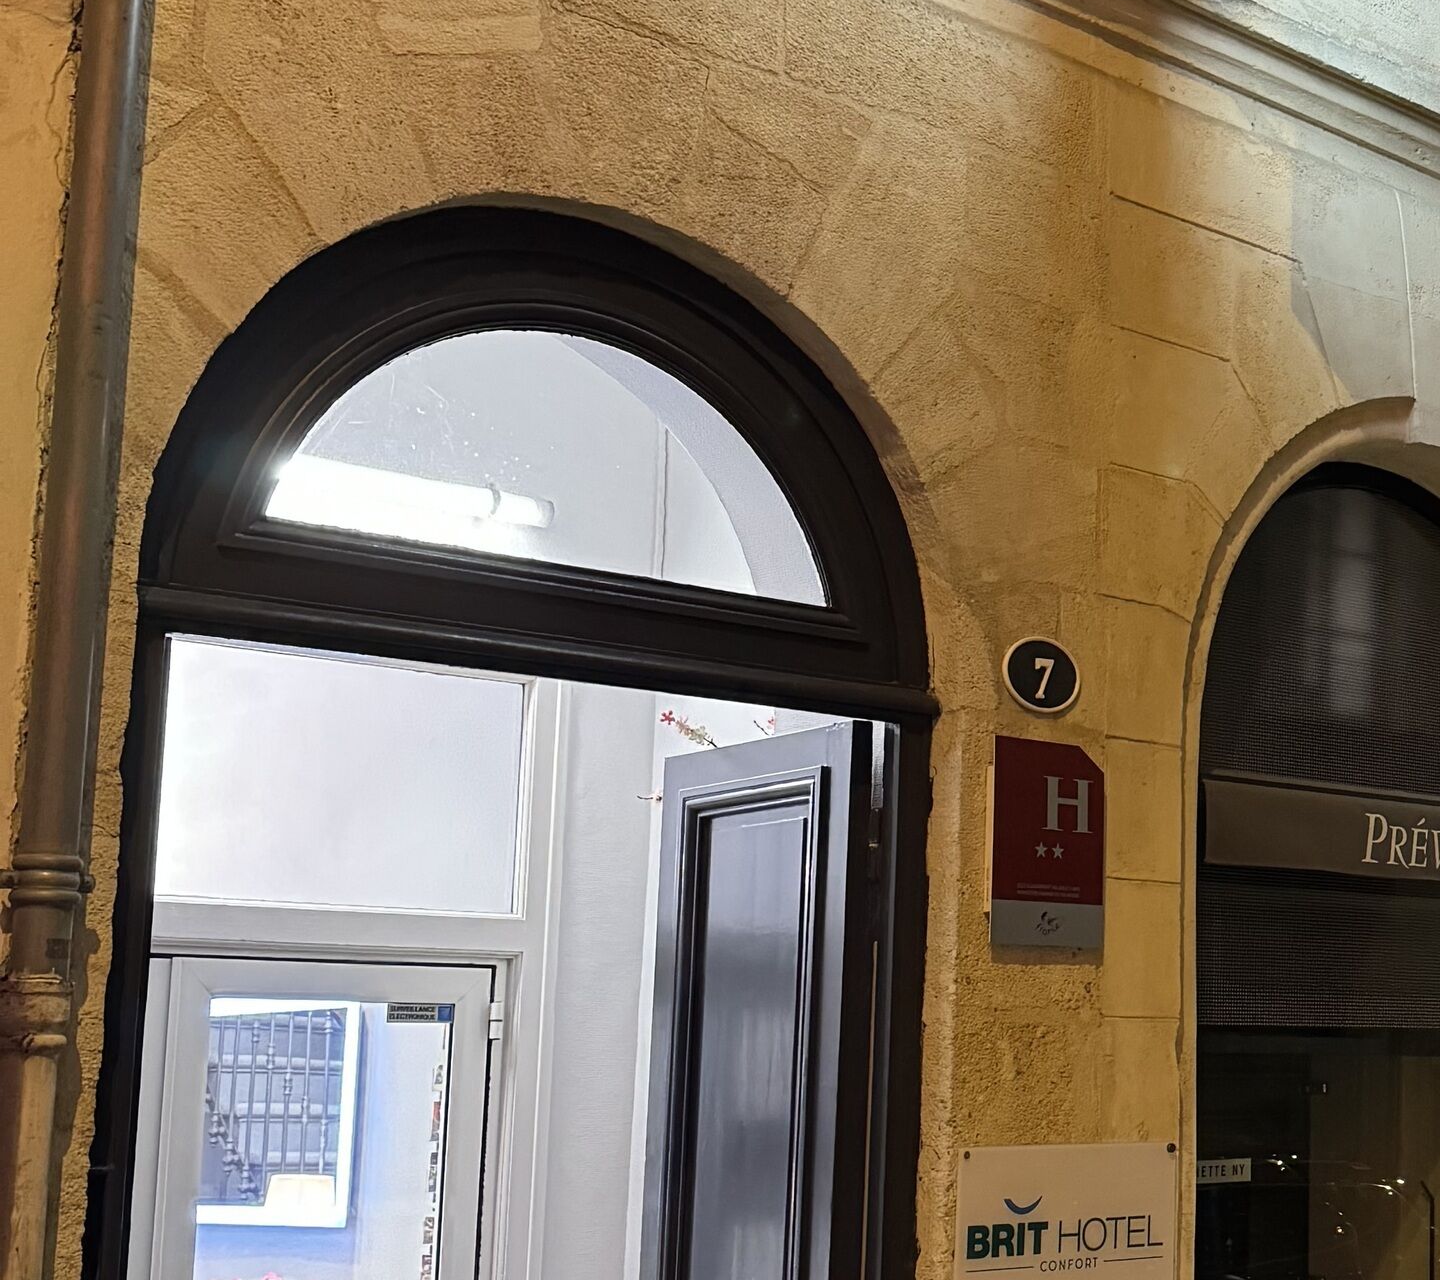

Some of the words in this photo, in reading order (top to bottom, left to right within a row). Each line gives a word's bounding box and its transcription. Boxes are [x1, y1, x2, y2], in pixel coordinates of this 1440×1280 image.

[1035, 657, 1055, 699] 7
[1042, 775, 1094, 834] H
[1197, 1164, 1227, 1177] ETTE
[1232, 1163, 1245, 1176] NY
[966, 1220, 1049, 1260] BRIT
[1057, 1214, 1164, 1254] HOTEL
[1039, 1256, 1099, 1272] CONFORT
